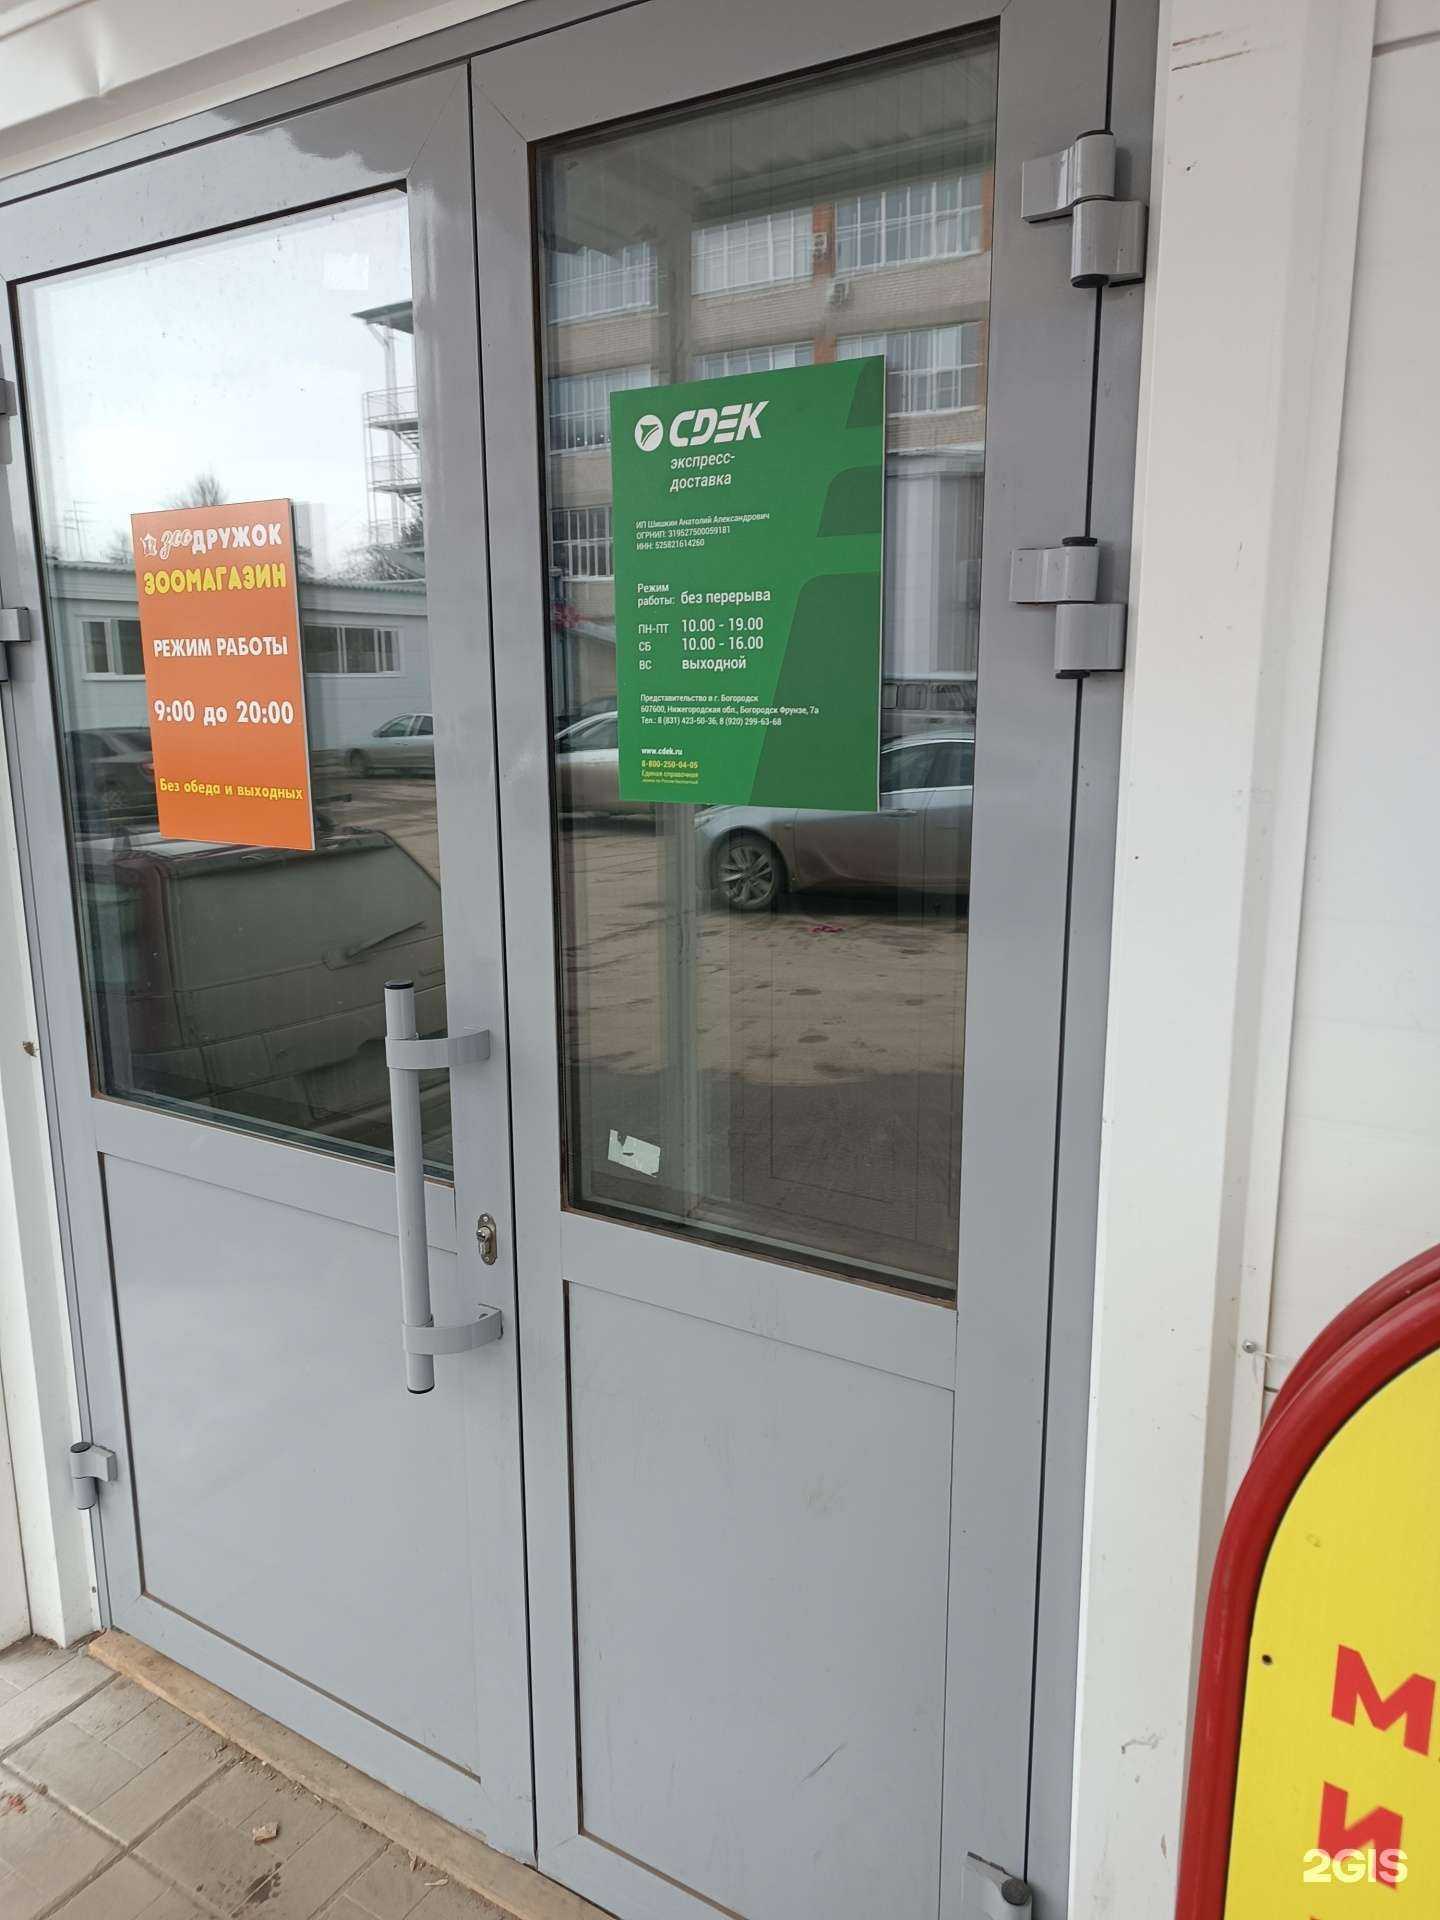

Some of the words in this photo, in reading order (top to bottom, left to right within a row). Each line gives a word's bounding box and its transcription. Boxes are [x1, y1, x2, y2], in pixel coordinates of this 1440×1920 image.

[669, 400, 769, 448] CDEK
[670, 452, 735, 470] экспресс-
[669, 473, 732, 493] доставка
[635, 520, 647, 530] ИП
[678, 516, 712, 526] Анатолий
[712, 513, 770, 524] Александрович
[143, 562, 287, 596] ЗООМАГАЗИН
[637, 583, 670, 593] Режим
[637, 594, 676, 608] работы:
[681, 591, 703, 605] без
[706, 590, 771, 606] перерыва
[638, 623, 670, 635] ПН-ПТ
[681, 618, 716, 633] 10.00
[728, 616, 764, 632] 19.00
[153, 638, 213, 658] РЕЖИМ
[216, 636, 289, 657] РАБОТЫ
[638, 641, 652, 652] СБ
[681, 637, 716, 651] 10.00
[728, 636, 764, 650] 16.00
[639, 660, 653, 670] ВС
[681, 655, 747, 672] выходной
[720, 694, 759, 704] Богородск
[154, 699, 195, 722] 9:00
[203, 706, 228, 727] до
[236, 700, 295, 725] 20:00
[667, 705, 721, 715] Нижегородская
[740, 705, 778, 715] Богородск
[725, 717, 744, 727] (920)
[641, 747, 683, 756] www.cdek.ru
[159, 778, 181, 792] Без
[183, 779, 221, 796] обеда
[224, 784, 234, 795] и
[237, 785, 304, 800] выходных
